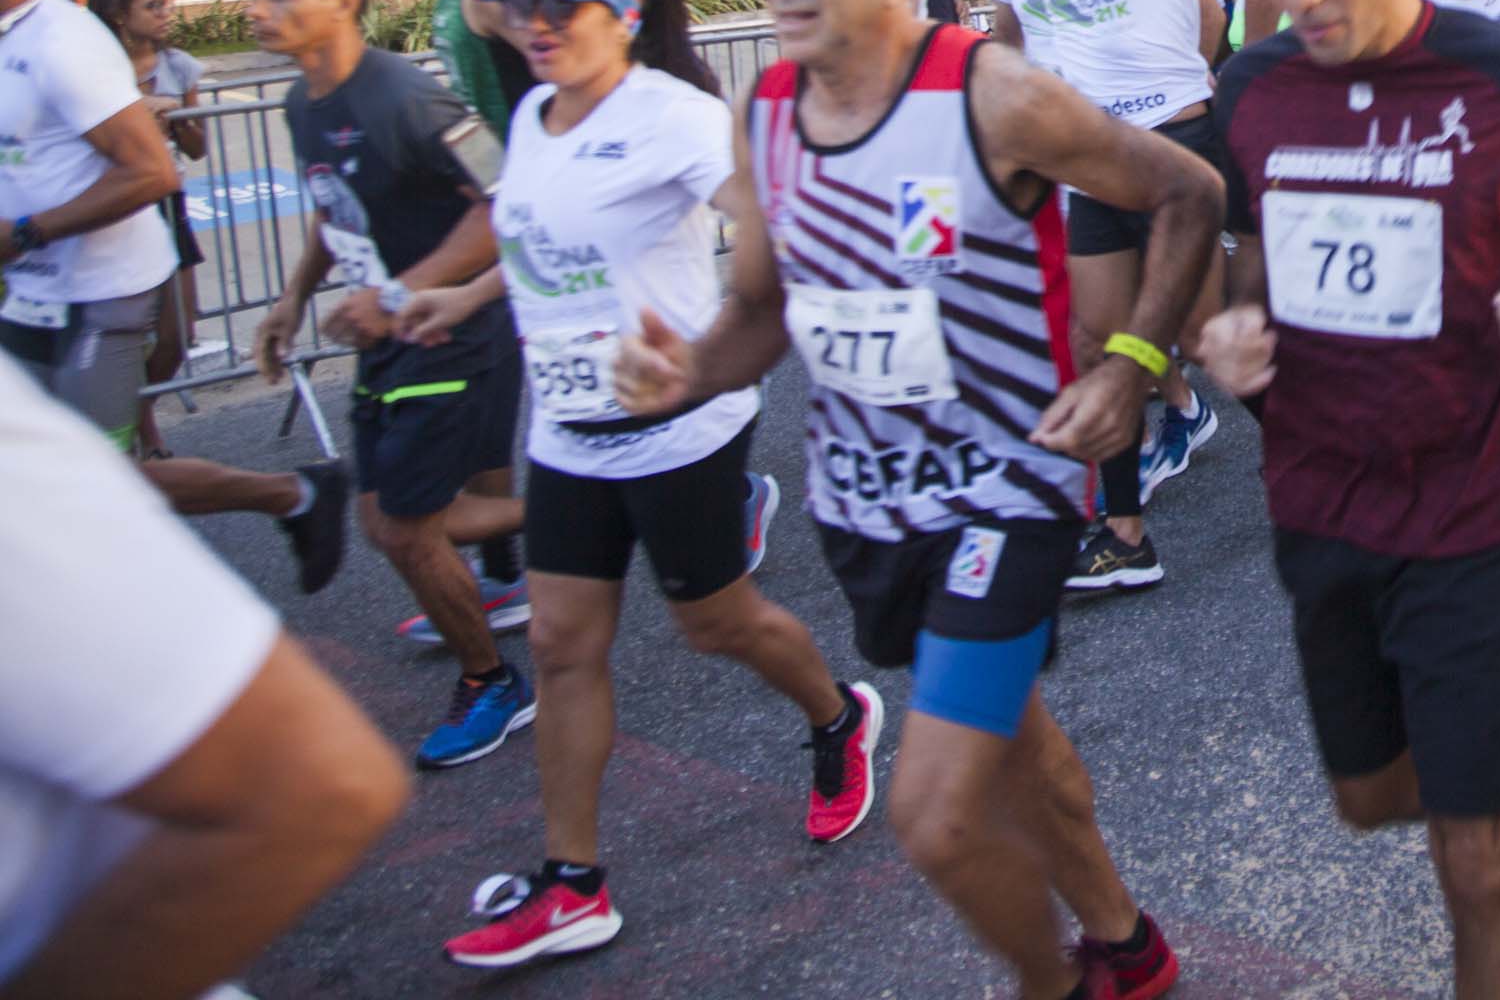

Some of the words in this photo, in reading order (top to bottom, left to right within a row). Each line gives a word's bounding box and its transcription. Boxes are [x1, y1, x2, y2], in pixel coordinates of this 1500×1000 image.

[1311, 240, 1376, 294] 78
[812, 326, 896, 376] 277
[828, 441, 1000, 500] CEFAP
